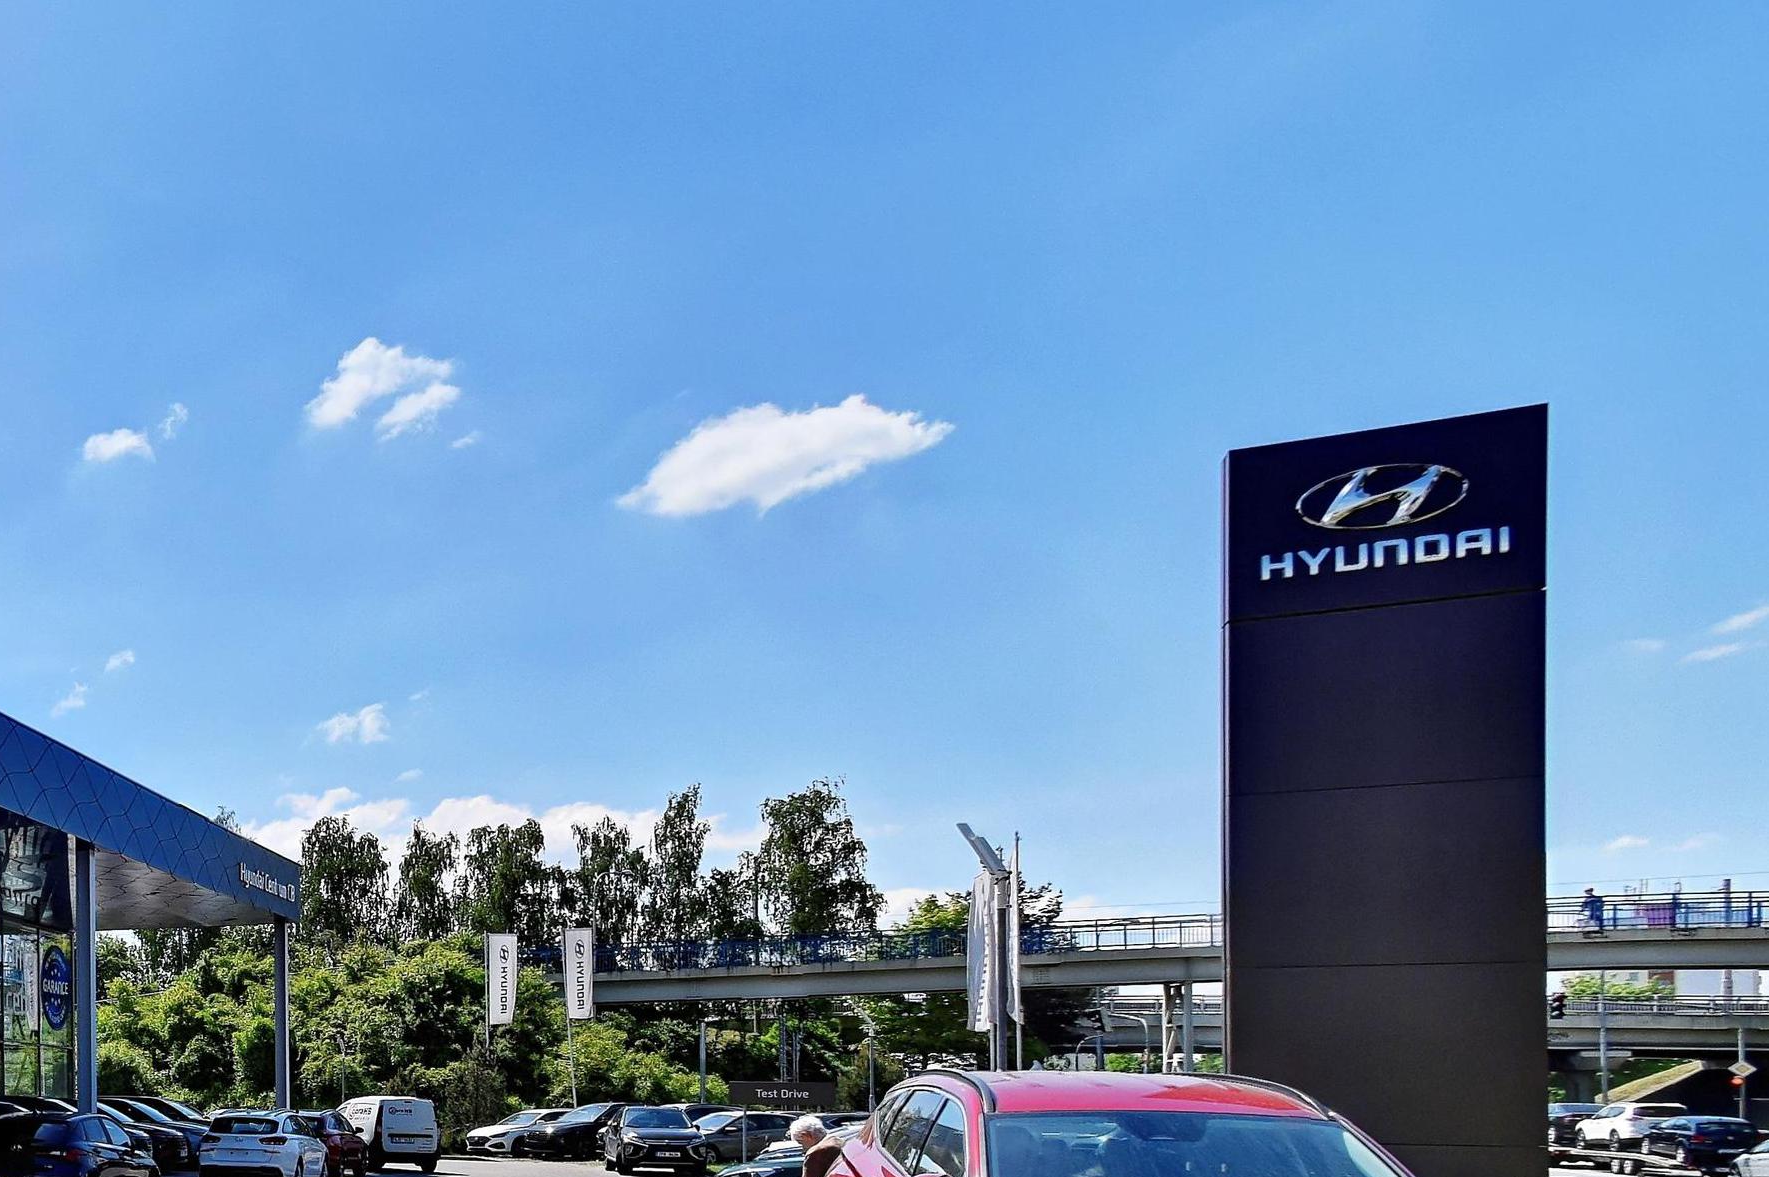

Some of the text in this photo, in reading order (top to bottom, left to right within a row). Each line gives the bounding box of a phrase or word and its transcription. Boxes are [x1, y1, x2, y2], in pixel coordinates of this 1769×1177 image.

[1260, 526, 1510, 581] HYUNDAI
[239, 862, 265, 889] Hyundai
[42, 978, 69, 995] GARANCE
[500, 966, 508, 1014] HYUNDAI
[576, 961, 585, 1010] HYUNDAI
[756, 1088, 809, 1098] Test Drive
